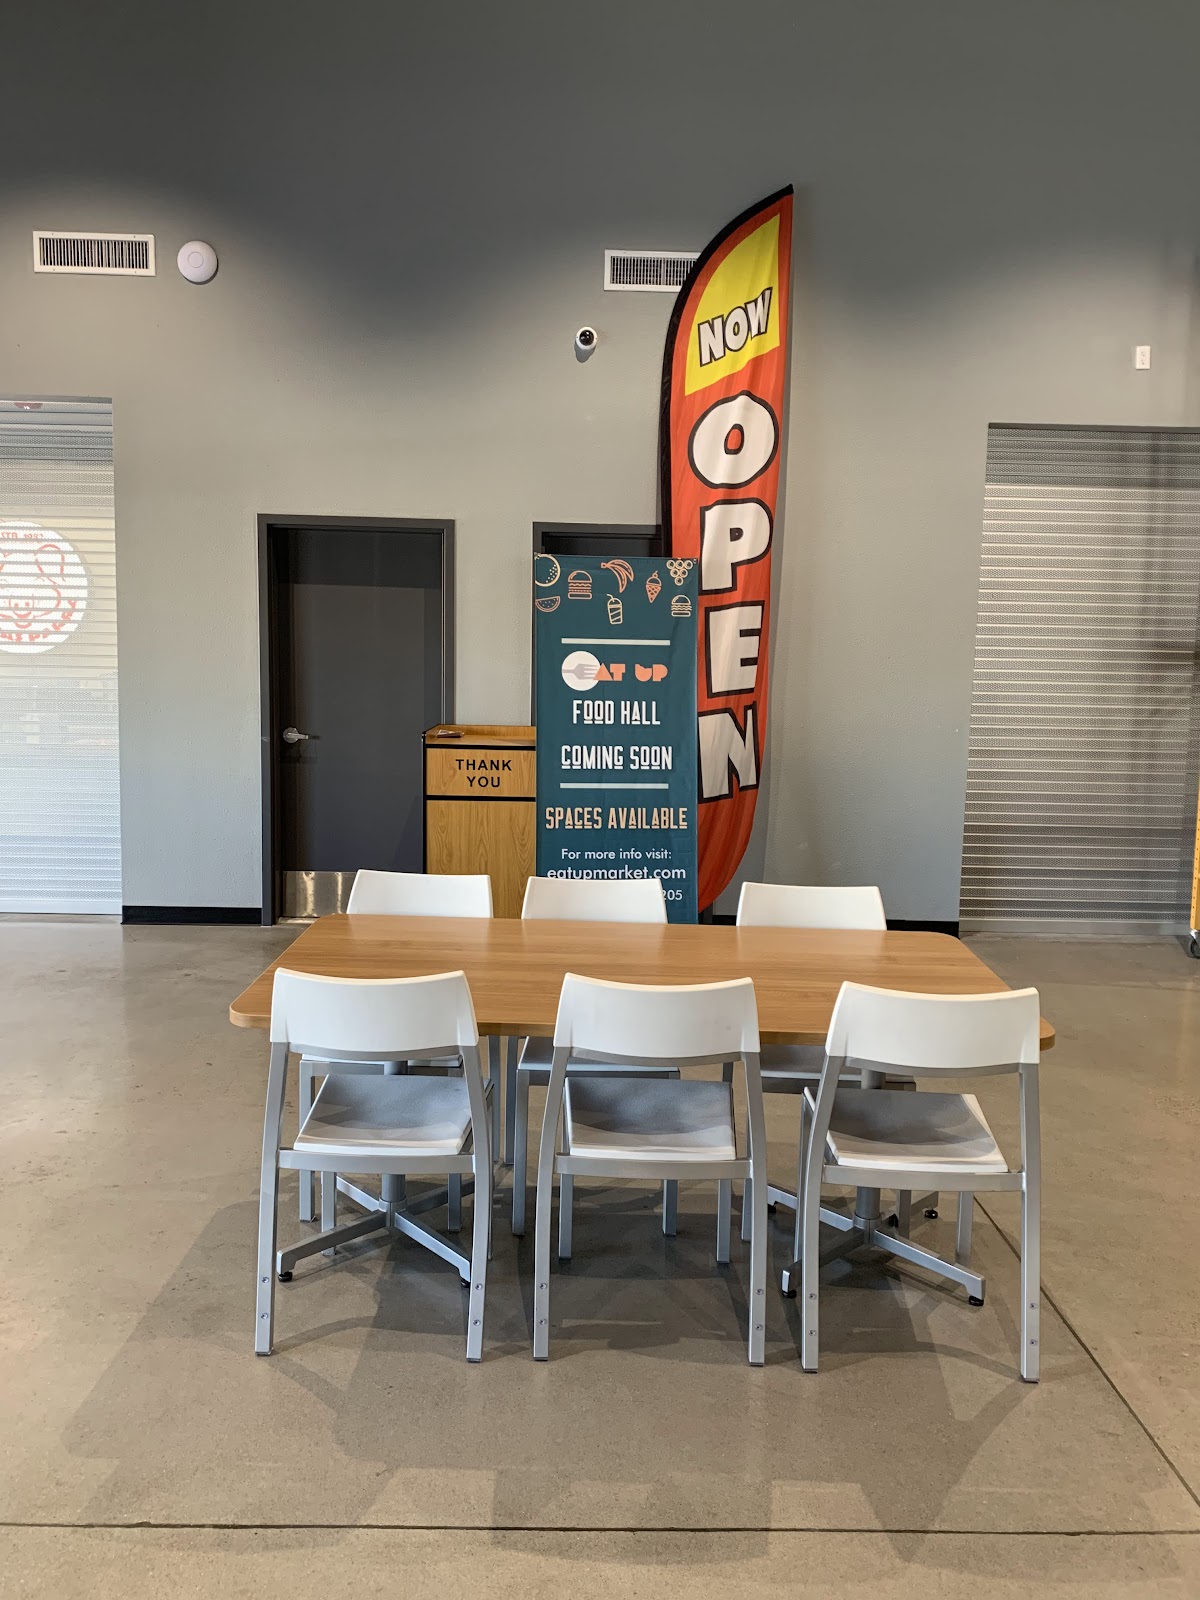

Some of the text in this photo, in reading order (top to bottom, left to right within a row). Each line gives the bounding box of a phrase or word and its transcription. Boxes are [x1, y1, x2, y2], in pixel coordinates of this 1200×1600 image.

[697, 286, 773, 367] NOW
[688, 390, 779, 801] OPEN
[635, 664, 668, 682] UP
[572, 700, 661, 725] FOOD HALL
[561, 745, 672, 770] COMING SOON
[455, 759, 512, 788] THANK YOU
[545, 807, 688, 829] SPACES AVAILABLE
[561, 848, 672, 859] For more info visit:
[547, 864, 686, 879] eatupmarket.com
